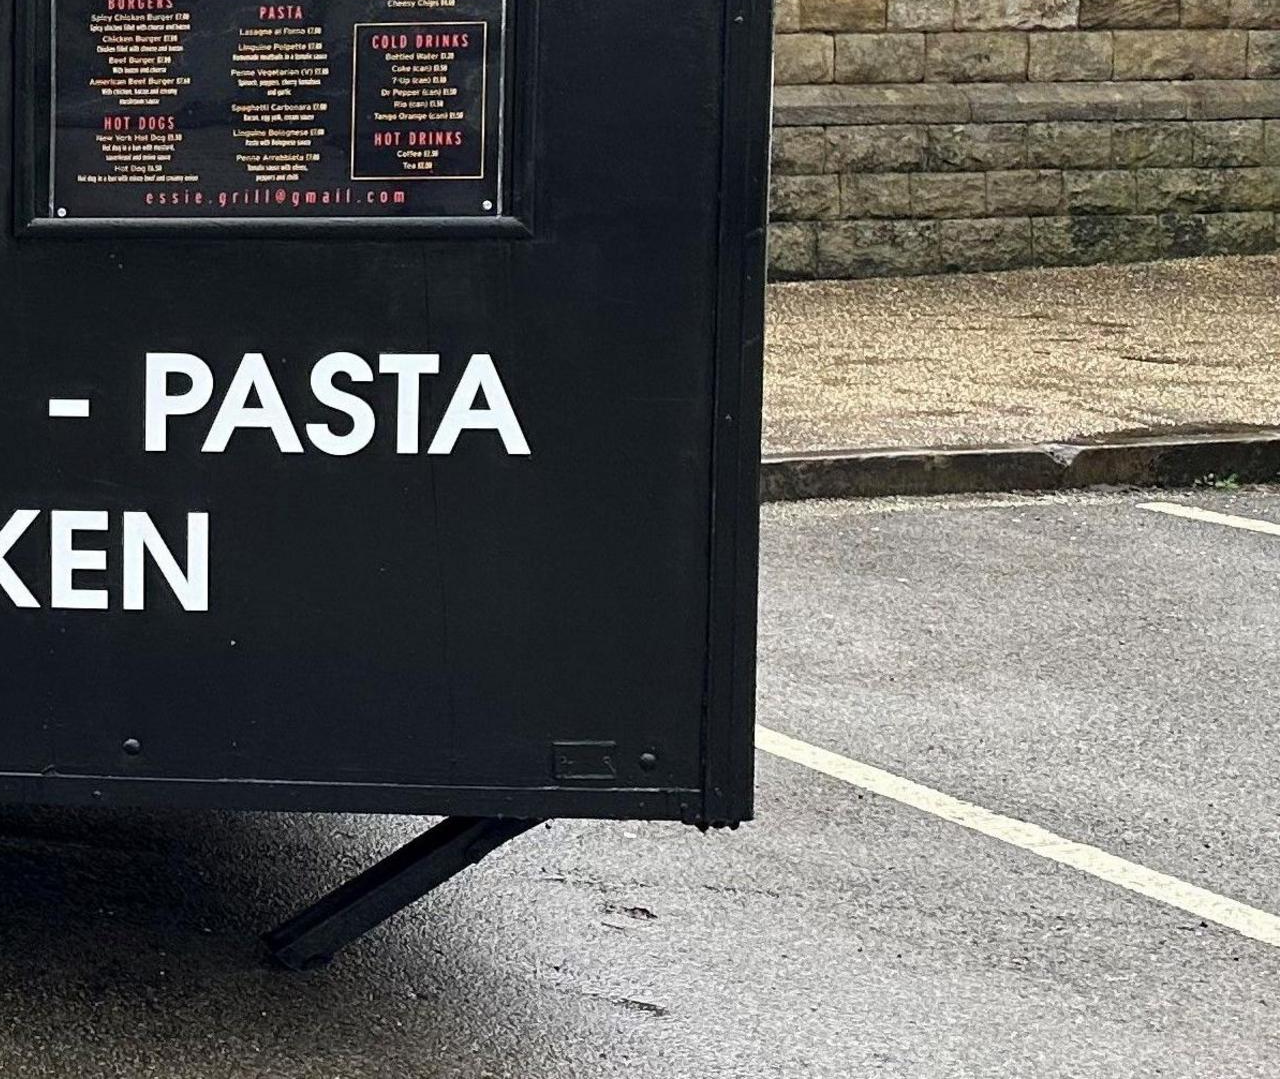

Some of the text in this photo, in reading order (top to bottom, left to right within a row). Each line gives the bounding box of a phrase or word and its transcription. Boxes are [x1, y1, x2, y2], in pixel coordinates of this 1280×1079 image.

[260, 6, 302, 19] PASTA
[372, 34, 469, 49] COLD DRINKS
[104, 116, 174, 130] HOT DOGS
[374, 132, 462, 146] HOT DRINKS
[146, 188, 406, 206] essie.grill@gmail.com
[145, 351, 532, 456] PASTA
